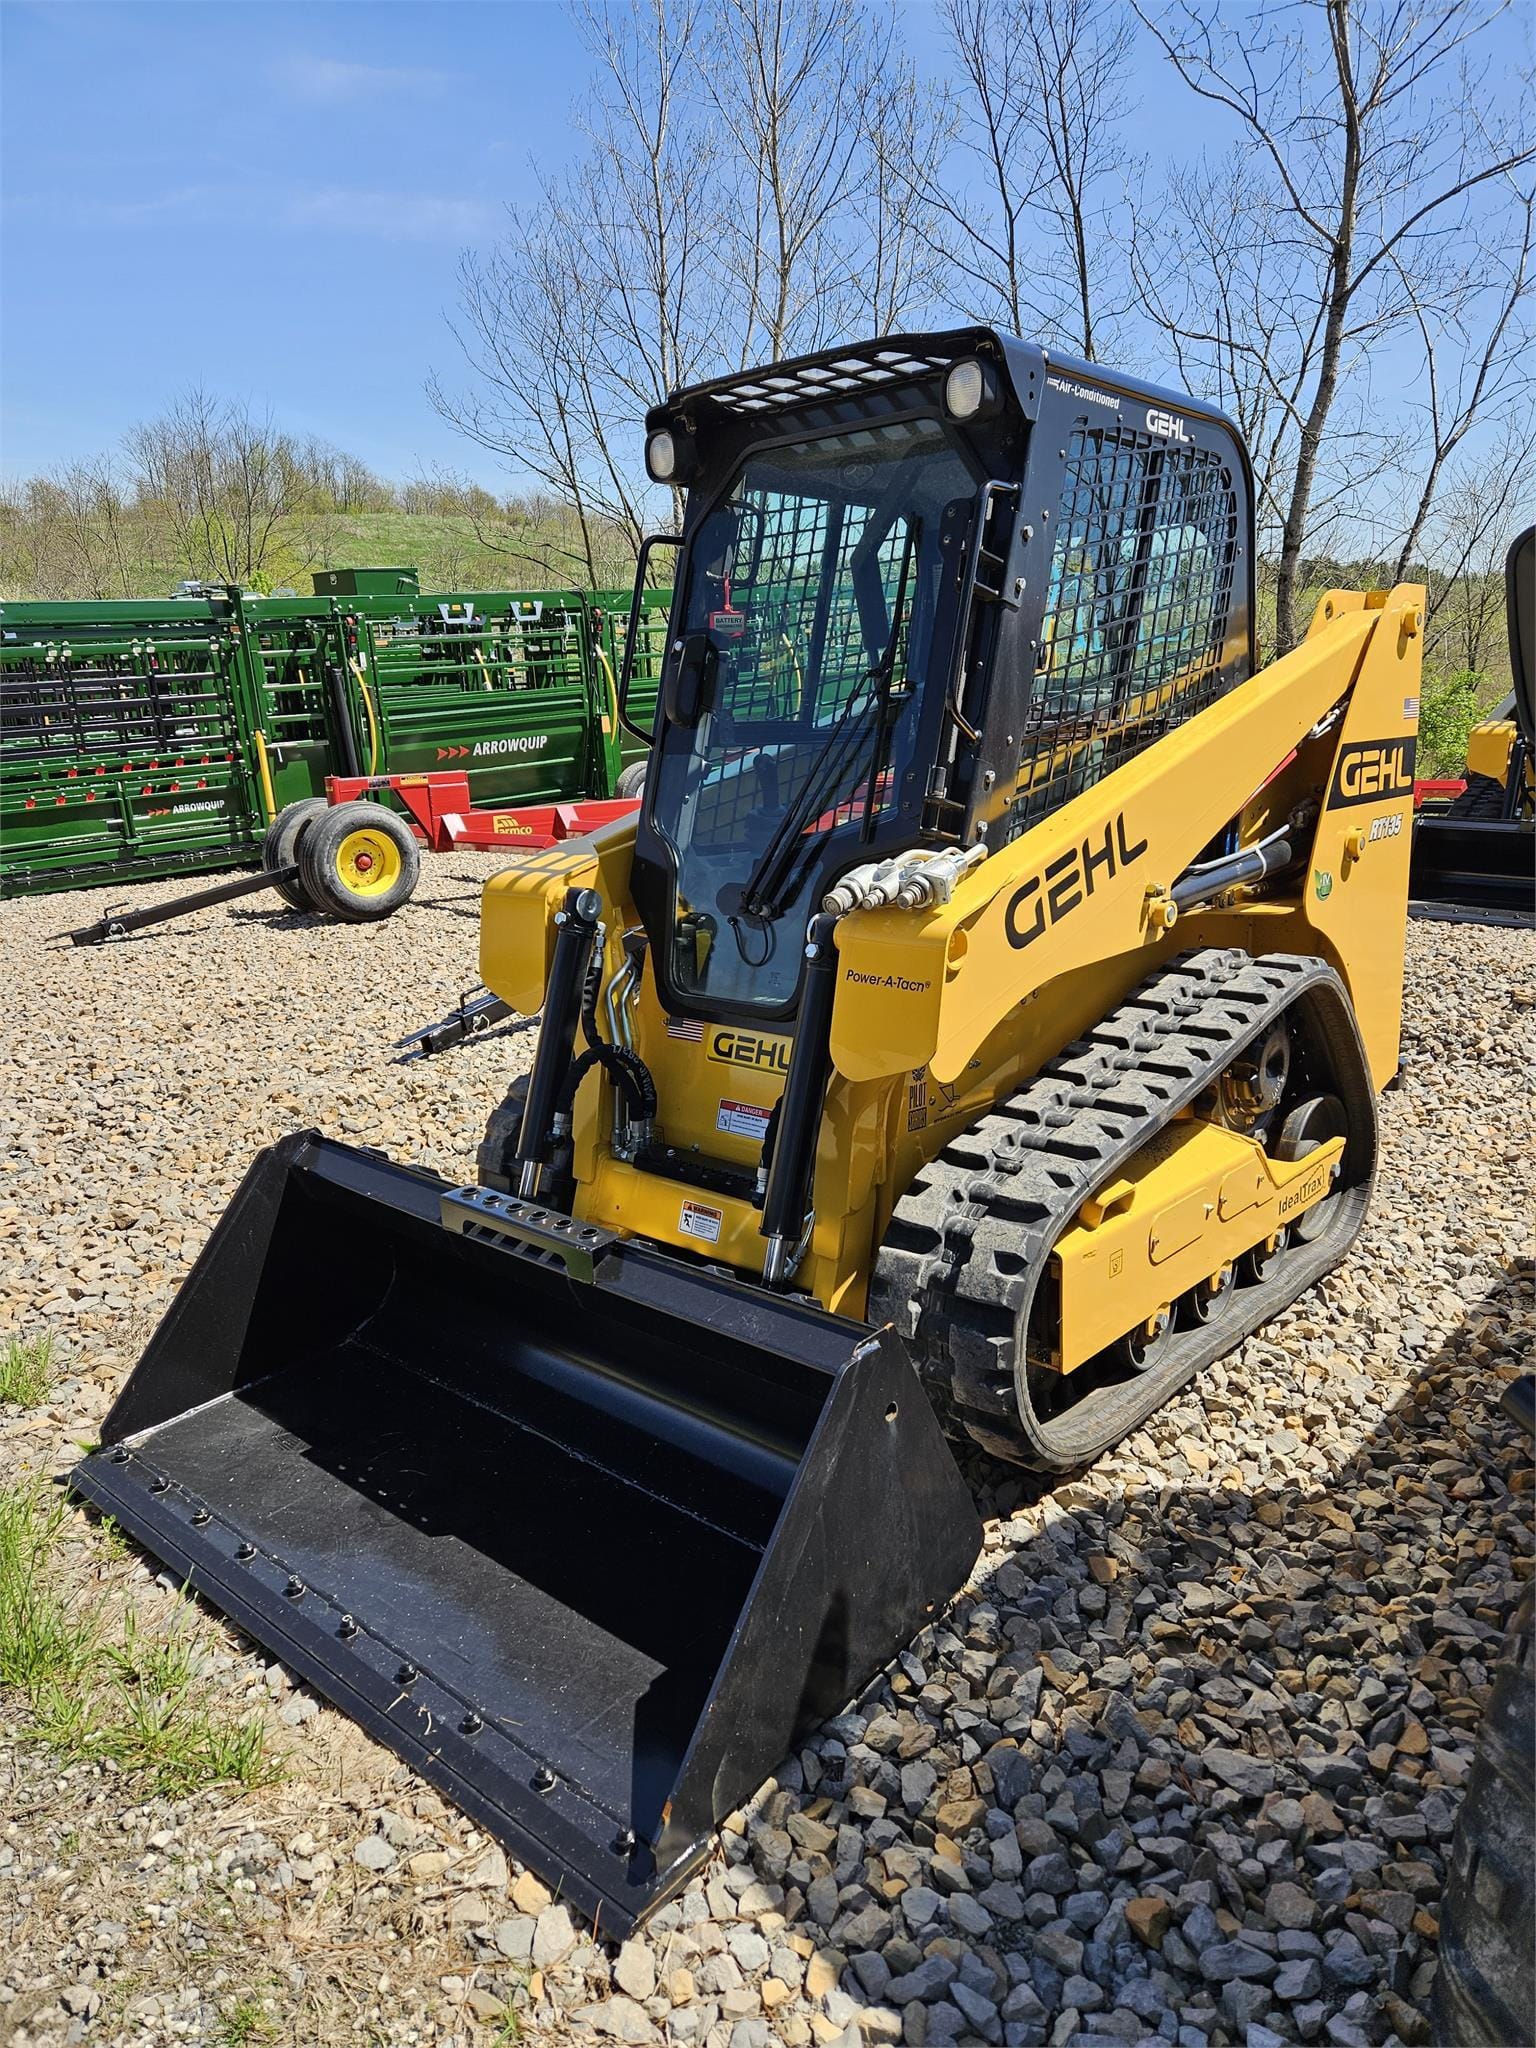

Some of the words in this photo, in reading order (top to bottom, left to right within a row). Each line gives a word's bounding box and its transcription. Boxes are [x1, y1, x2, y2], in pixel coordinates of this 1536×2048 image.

[1058, 379, 1121, 410] Air-Conditioned
[1146, 408, 1190, 443] GEHL
[472, 735, 548, 756] ARROWQUIP
[1340, 746, 1412, 798] GEHL
[172, 799, 225, 815] ARROWQUIP
[1368, 812, 1404, 843] RT135
[1004, 811, 1149, 950] GEHL
[713, 1031, 790, 1070] GEHL
[741, 1106, 763, 1117] DANGER
[1278, 1175, 1322, 1217] IdealTrax
